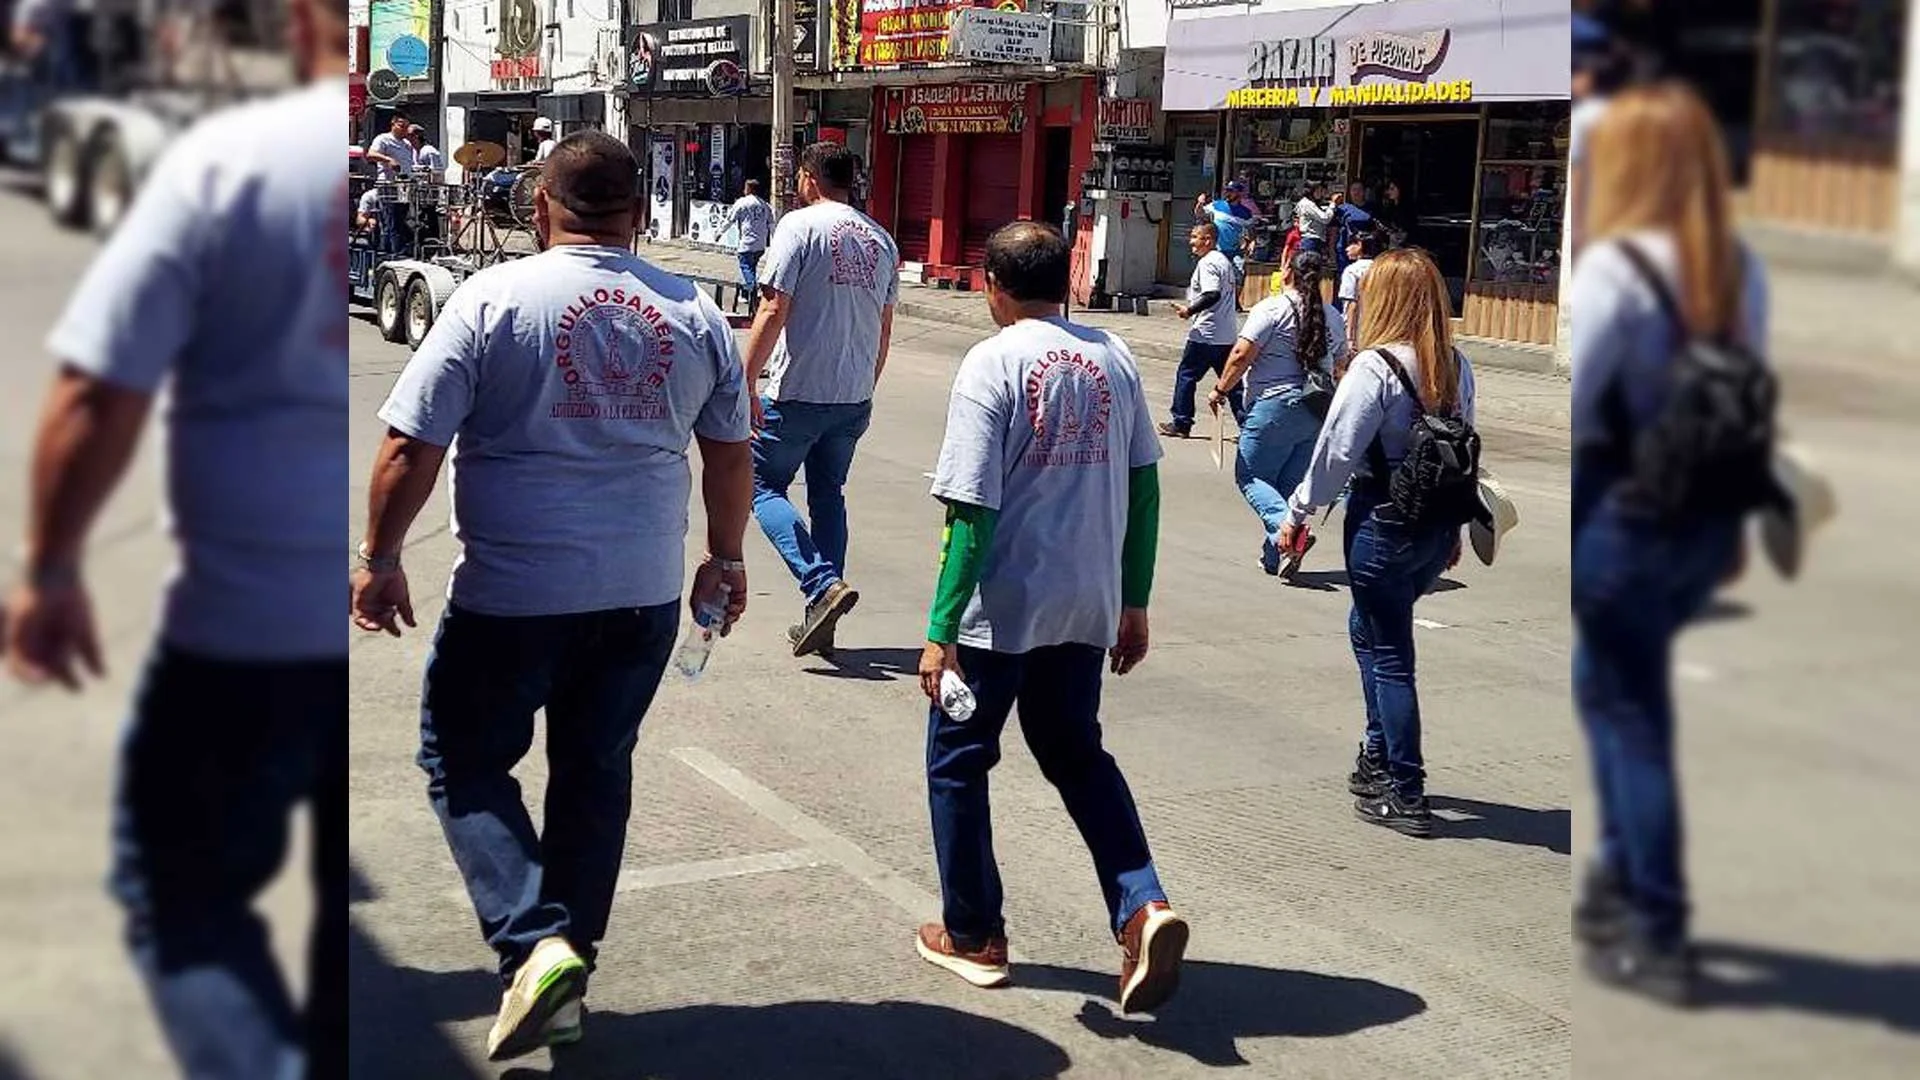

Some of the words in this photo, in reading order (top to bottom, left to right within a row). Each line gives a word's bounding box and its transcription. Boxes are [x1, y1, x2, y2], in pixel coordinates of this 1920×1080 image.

[1248, 37, 1335, 83] BAZAR
[1351, 43, 1367, 66] DE
[1371, 38, 1426, 71] PIEDRAS
[961, 85, 985, 103] LAS
[1226, 87, 1299, 108] MERCERIA
[1309, 85, 1321, 106] Y
[1329, 80, 1473, 105] MANUALIDADES
[555, 288, 674, 388] ORGULLOSAMENTE
